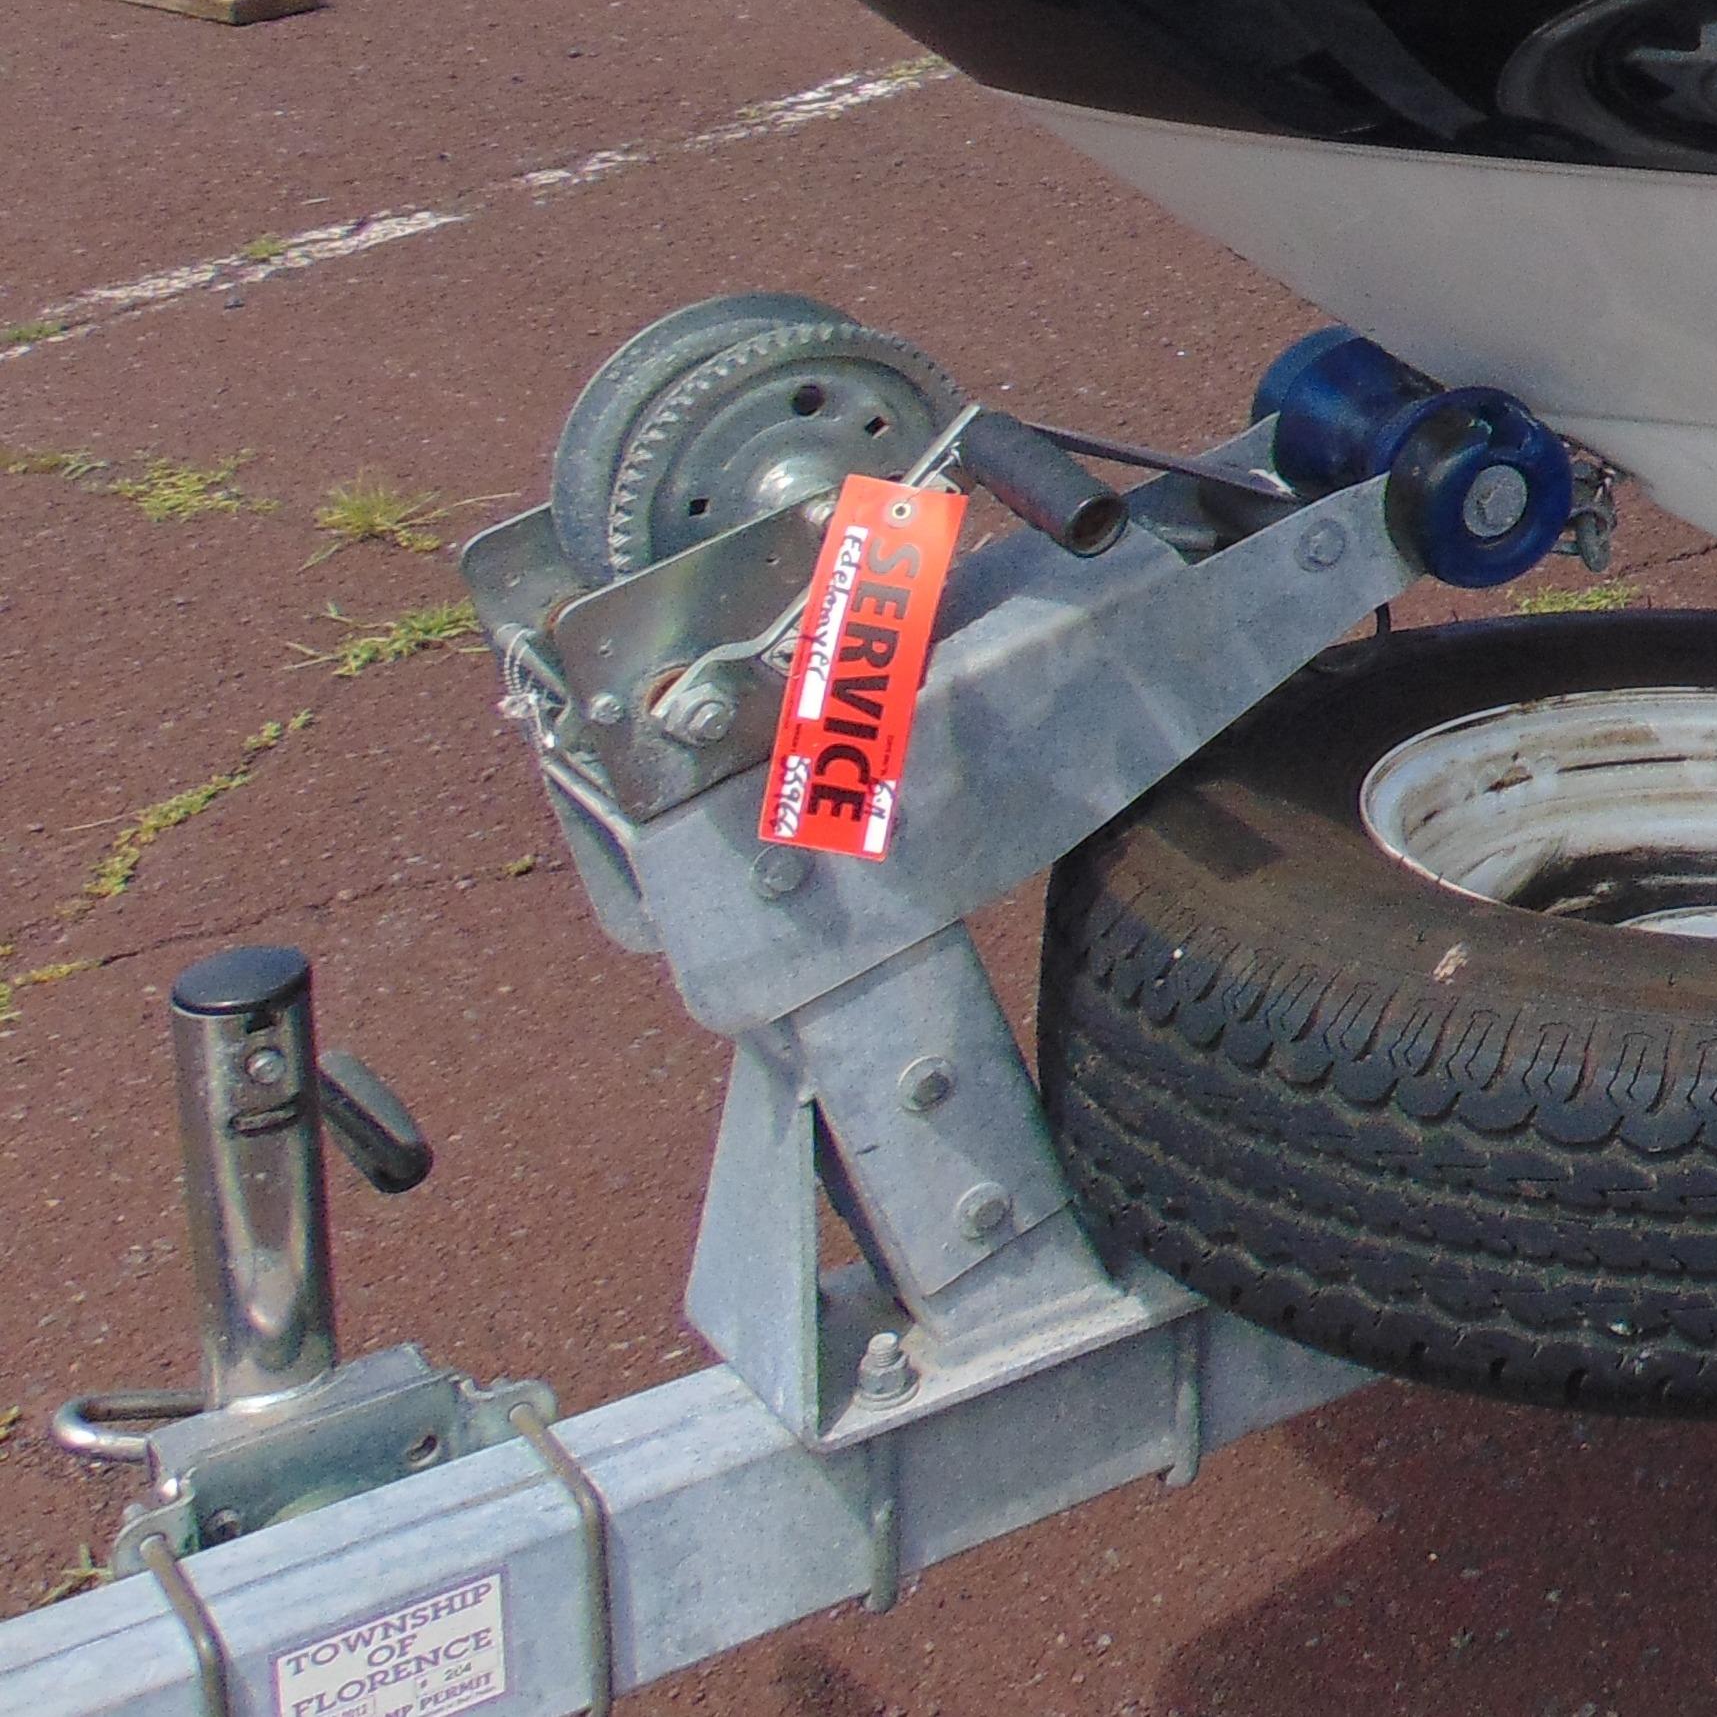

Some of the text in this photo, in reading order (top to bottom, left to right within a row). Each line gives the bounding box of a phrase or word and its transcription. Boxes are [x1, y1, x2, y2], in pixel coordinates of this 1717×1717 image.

[807, 537, 921, 822] SERVICE
[286, 1582, 492, 1676] TOWNSHIP
[292, 1627, 493, 1717] FLORENCE
[367, 1633, 418, 1667] OF
[419, 1672, 493, 1711] PERMIT
